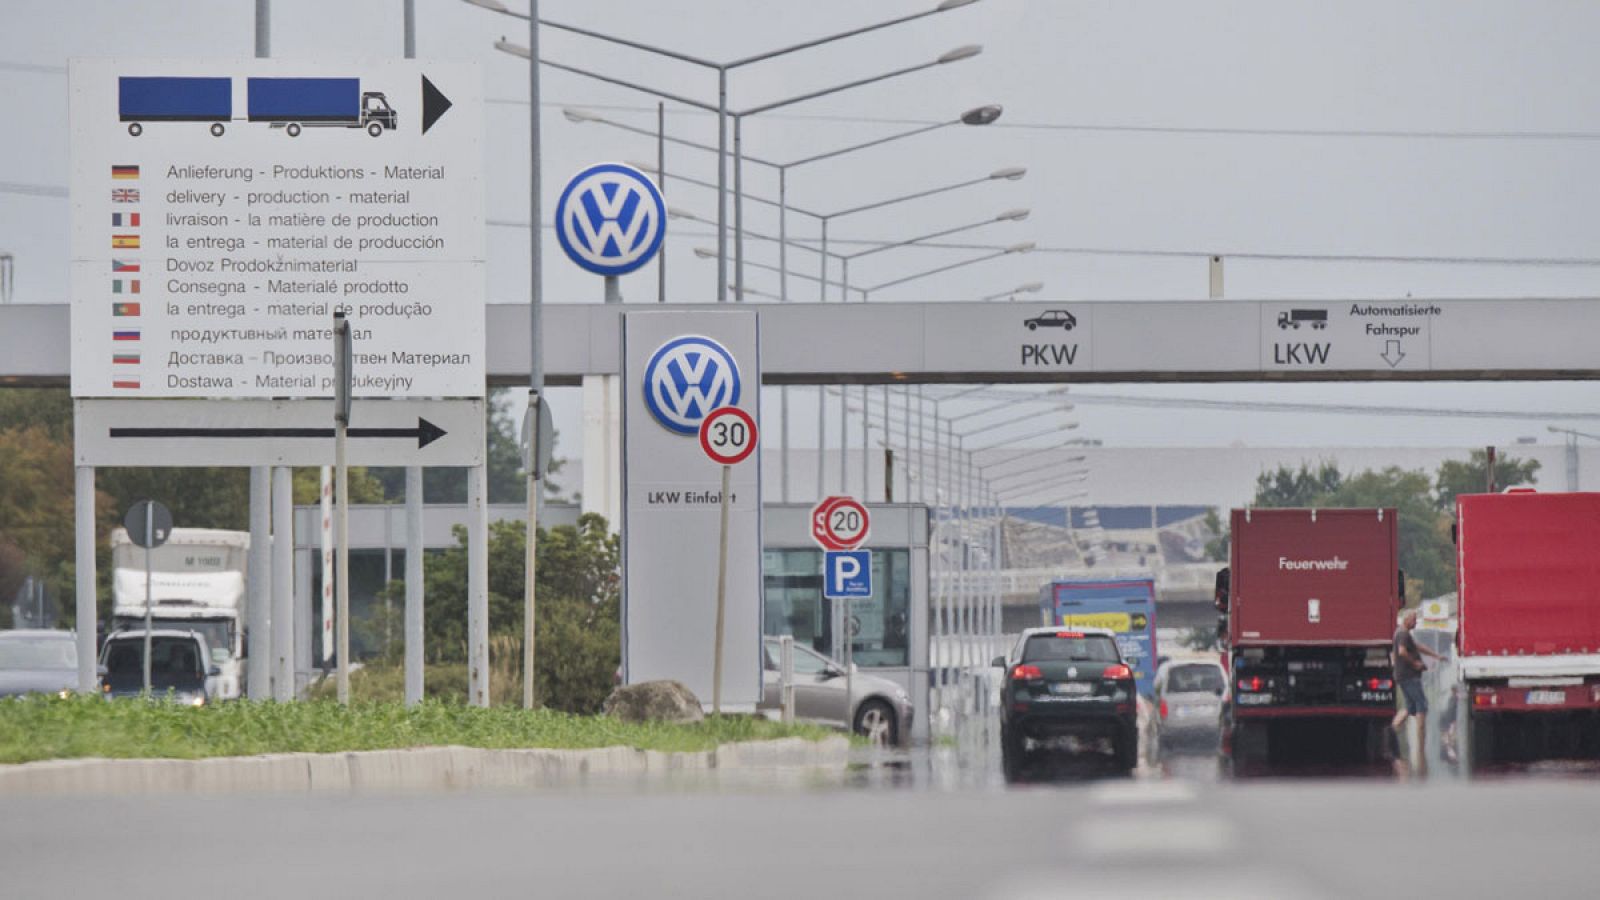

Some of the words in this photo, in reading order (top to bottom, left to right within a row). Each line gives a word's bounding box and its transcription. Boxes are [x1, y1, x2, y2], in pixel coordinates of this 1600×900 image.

[166, 165, 253, 182] Anlieferung
[273, 165, 364, 179] Produktions
[385, 165, 444, 179] Material
[166, 189, 226, 207] delivery
[247, 190, 330, 207] production
[350, 190, 410, 204] material
[166, 213, 228, 226] livraison
[248, 213, 261, 226] la
[269, 212, 326, 227] matière
[331, 213, 352, 227] de
[357, 213, 439, 229] production
[166, 235, 179, 248] la
[186, 236, 245, 252] entrega
[267, 235, 328, 248] material
[333, 235, 353, 249] de
[359, 235, 445, 252] producción
[167, 258, 214, 272] Dovoz
[167, 279, 246, 296] Consegna
[267, 279, 338, 294] Materialé
[344, 280, 409, 296] prodotto
[167, 301, 180, 315] la
[187, 302, 245, 319] entrega
[267, 302, 328, 316] material
[360, 302, 432, 319] produção
[1350, 303, 1442, 317] Automatisierte
[1366, 323, 1421, 338] Fahrspur
[168, 351, 244, 368] Доставка
[392, 351, 471, 367] Материал
[1021, 344, 1079, 366] PKW
[1274, 342, 1331, 364] LKW
[167, 374, 233, 388] Dostawa
[255, 375, 316, 388] Material
[712, 422, 745, 447] 30
[647, 491, 681, 504] LKW
[833, 511, 860, 532] 20
[1279, 555, 1349, 570] Feuerwehr
[835, 555, 861, 593] P
